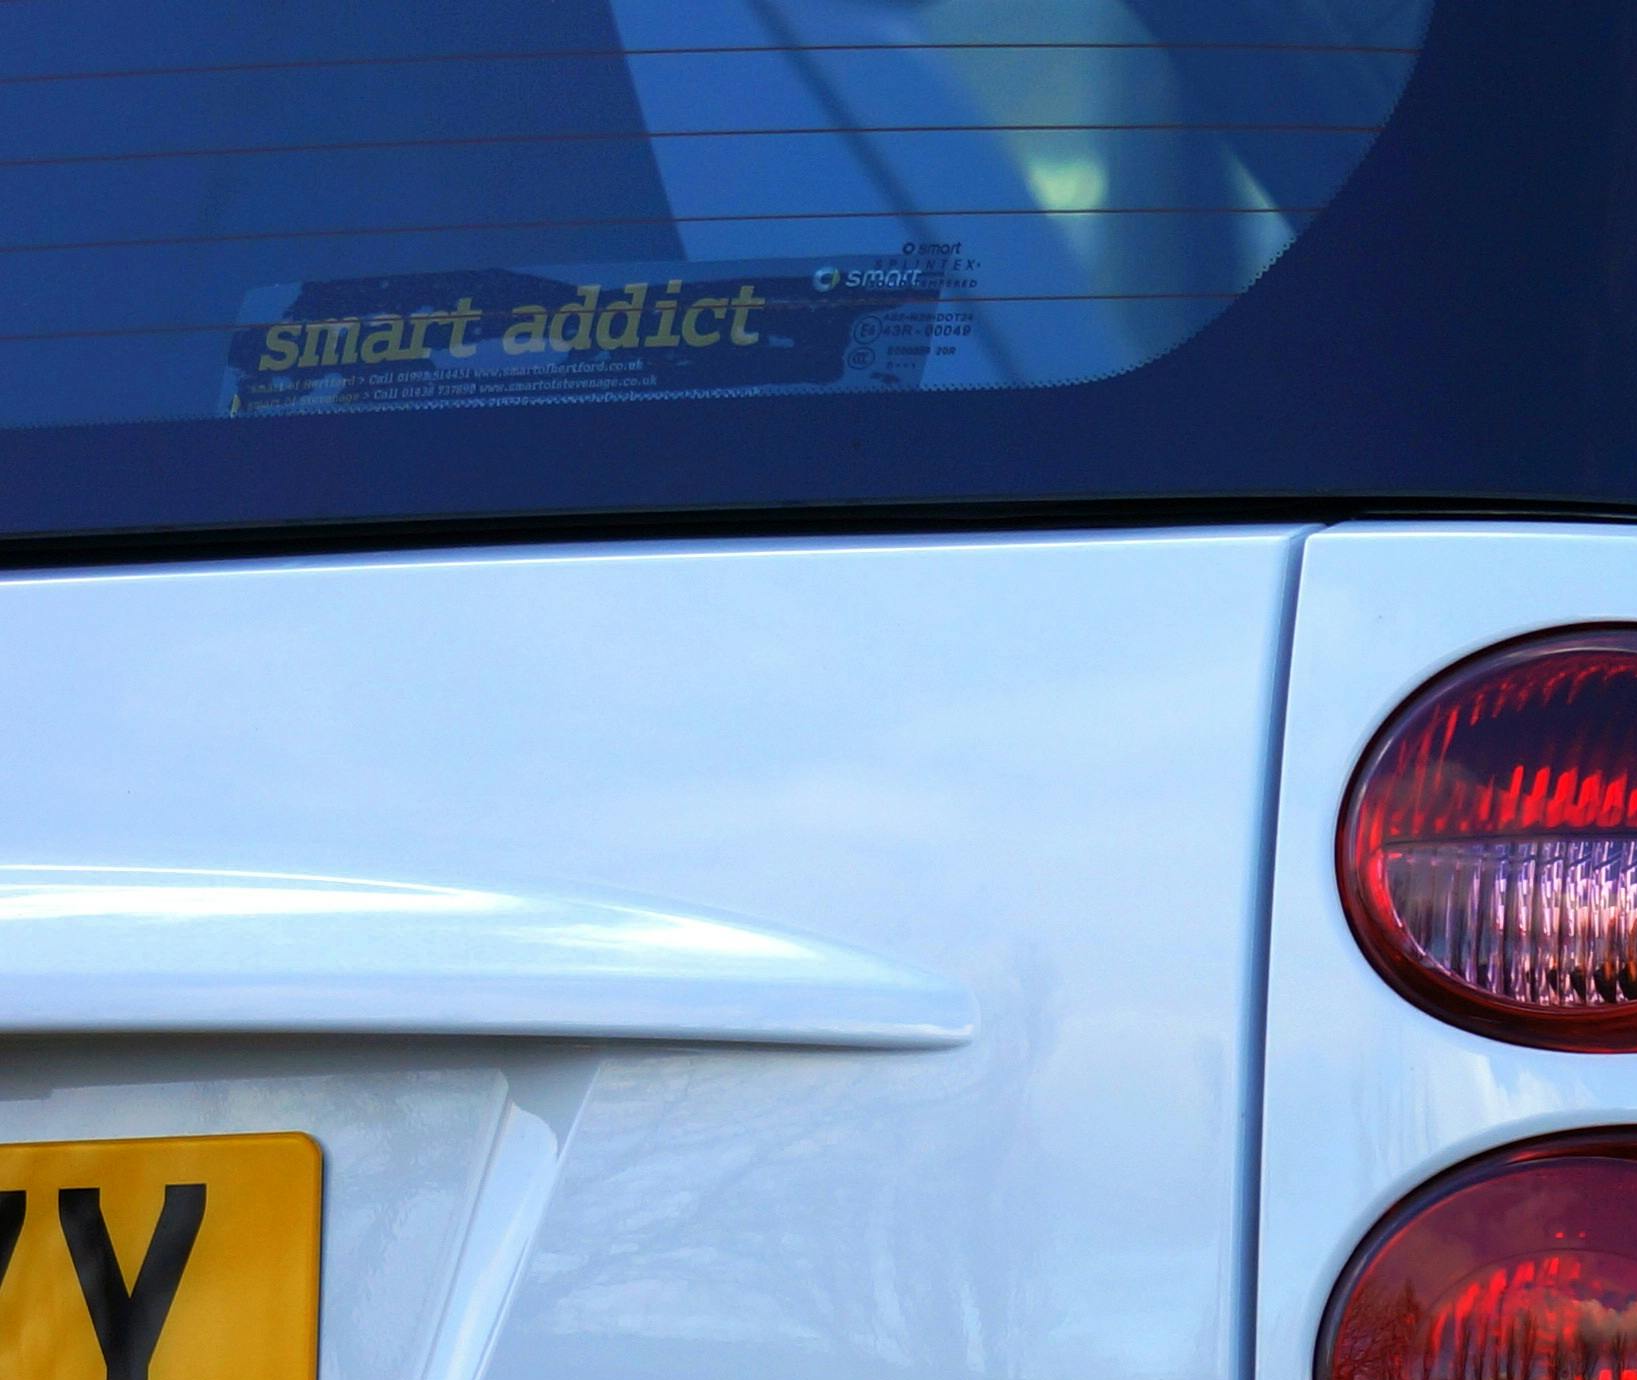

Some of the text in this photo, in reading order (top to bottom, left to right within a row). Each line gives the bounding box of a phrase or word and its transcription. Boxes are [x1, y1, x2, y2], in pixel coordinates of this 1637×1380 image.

[917, 241, 962, 255] smart
[874, 259, 976, 271] SPLINTEX
[845, 269, 923, 288] smart
[258, 279, 766, 372] smart addict
